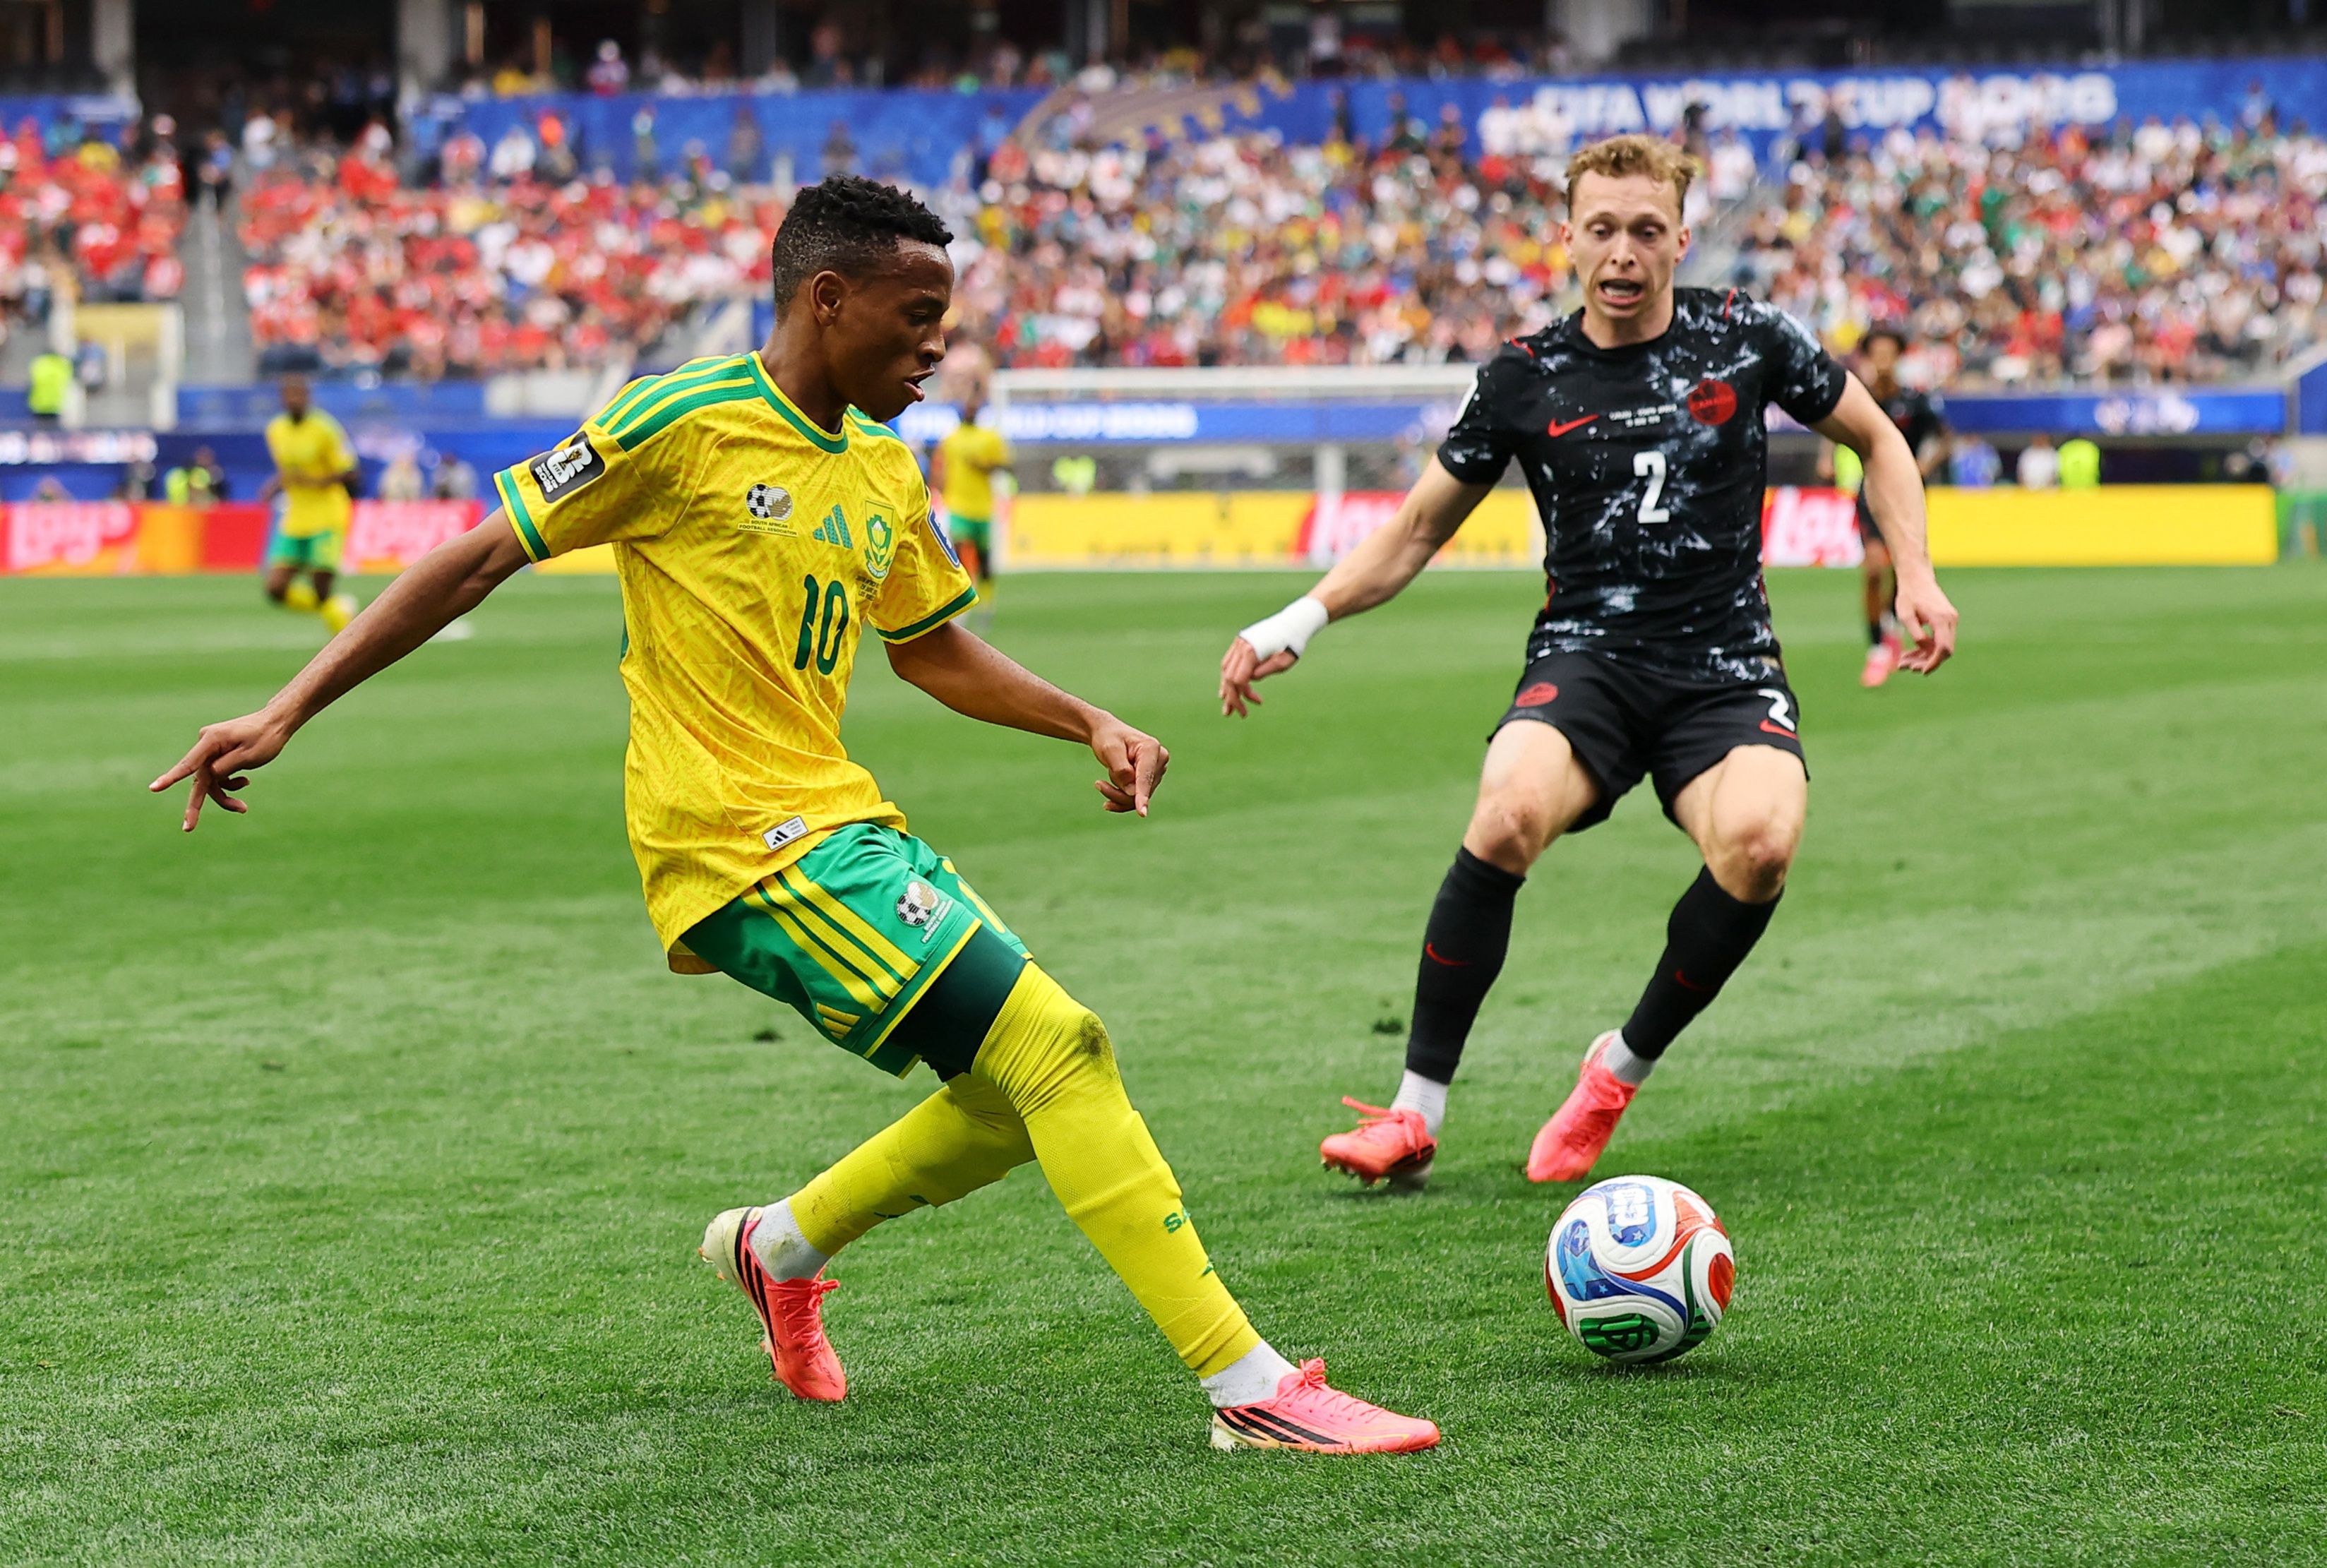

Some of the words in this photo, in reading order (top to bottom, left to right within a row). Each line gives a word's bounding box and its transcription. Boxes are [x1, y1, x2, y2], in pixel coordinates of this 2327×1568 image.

[535, 466, 554, 493] 2026
[553, 464, 563, 477] FIFA
[1633, 450, 1670, 524] 2
[767, 527, 797, 535] ASSOCIATION
[794, 573, 848, 675] 10
[1757, 688, 1795, 732] 2
